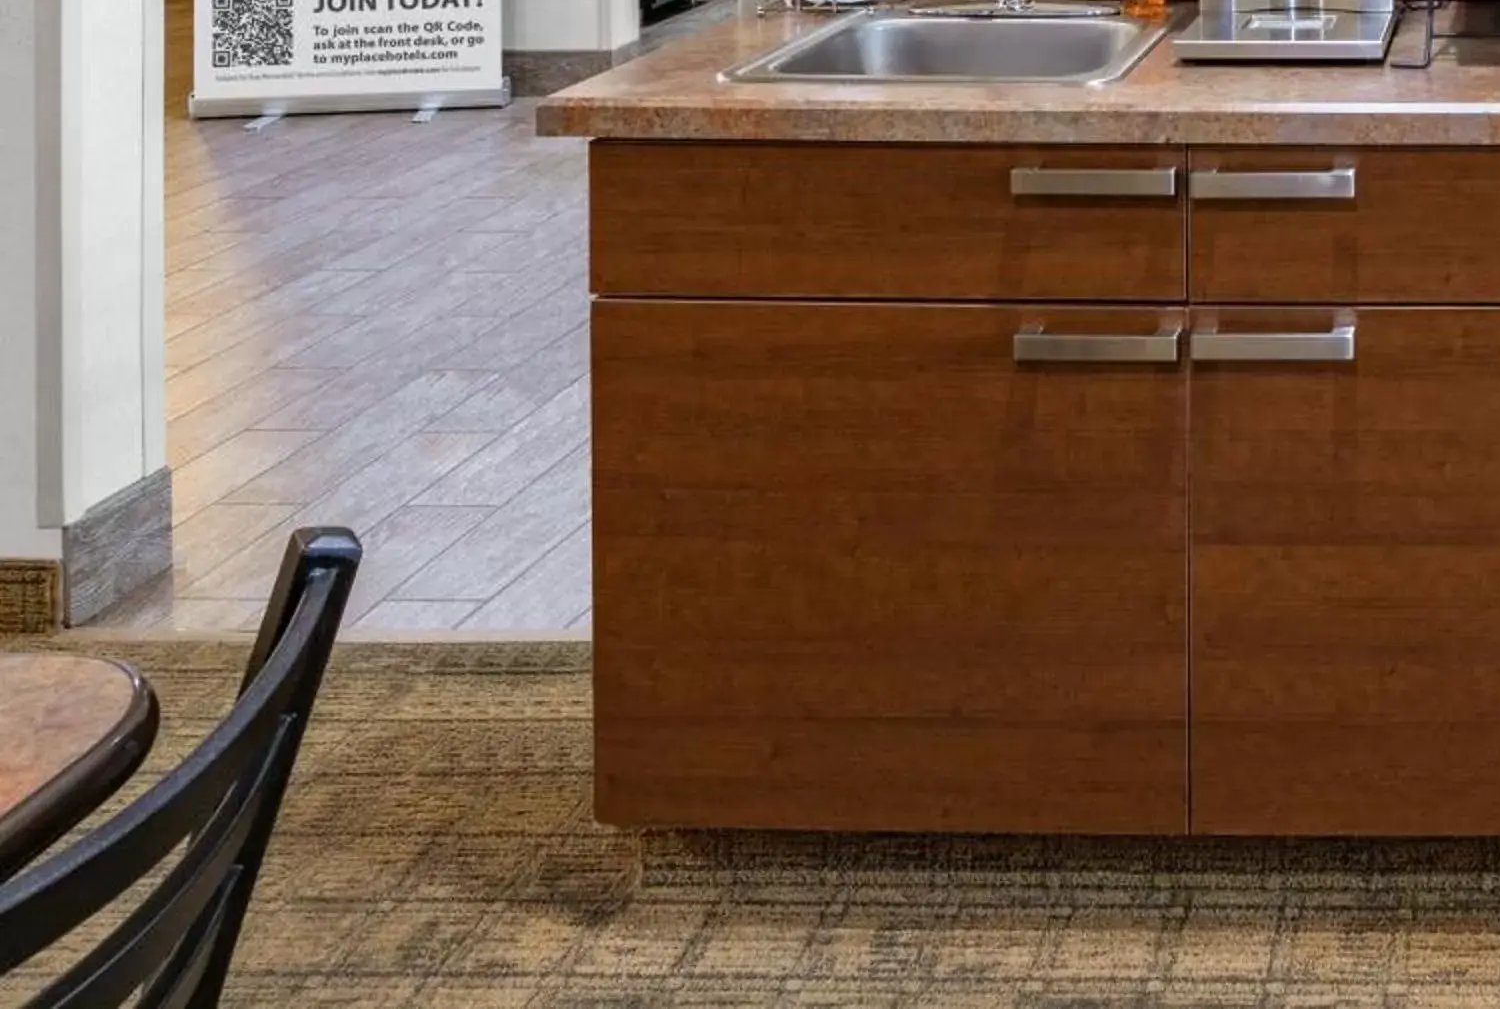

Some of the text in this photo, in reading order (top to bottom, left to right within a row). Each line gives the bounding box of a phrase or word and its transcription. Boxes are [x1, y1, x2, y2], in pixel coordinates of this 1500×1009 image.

[313, 25, 329, 36] To
[333, 23, 359, 38] join
[363, 25, 393, 35] scan
[397, 23, 420, 33] the
[423, 21, 443, 33] QR
[313, 35, 485, 50] ask at the front desk, or go
[313, 50, 458, 67] to myplacehotels.com
